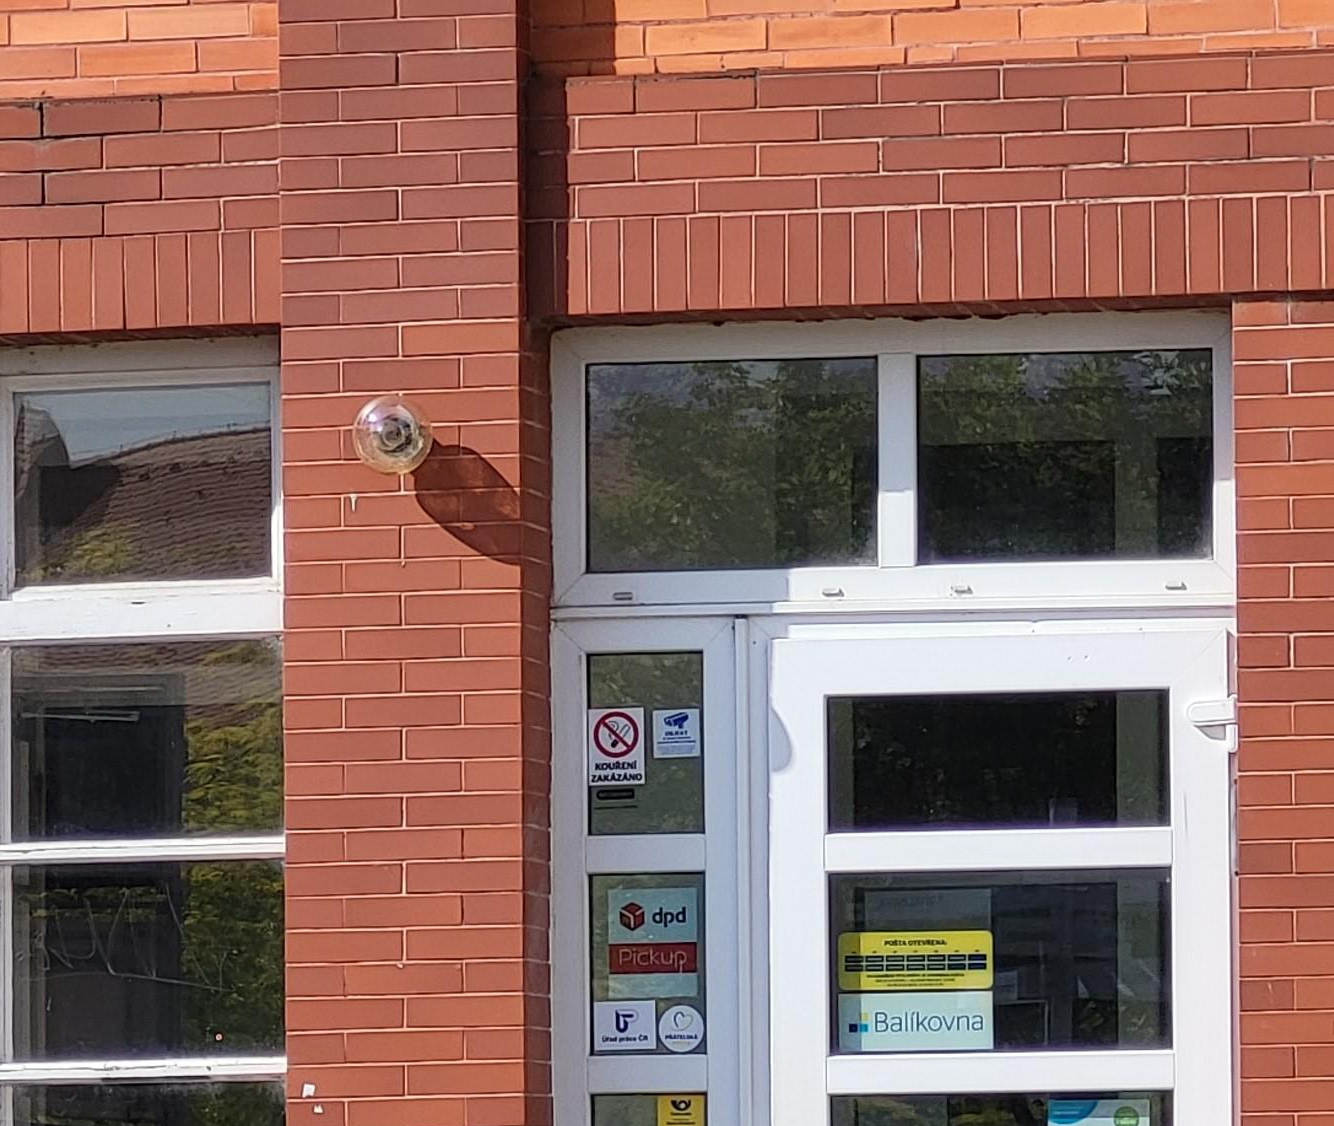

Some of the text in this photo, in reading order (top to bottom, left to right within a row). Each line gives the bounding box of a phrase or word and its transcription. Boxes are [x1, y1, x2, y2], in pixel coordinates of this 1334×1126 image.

[652, 906, 687, 928] dpd
[618, 947, 688, 973] Pickup
[874, 1010, 984, 1033] Balíkovna
